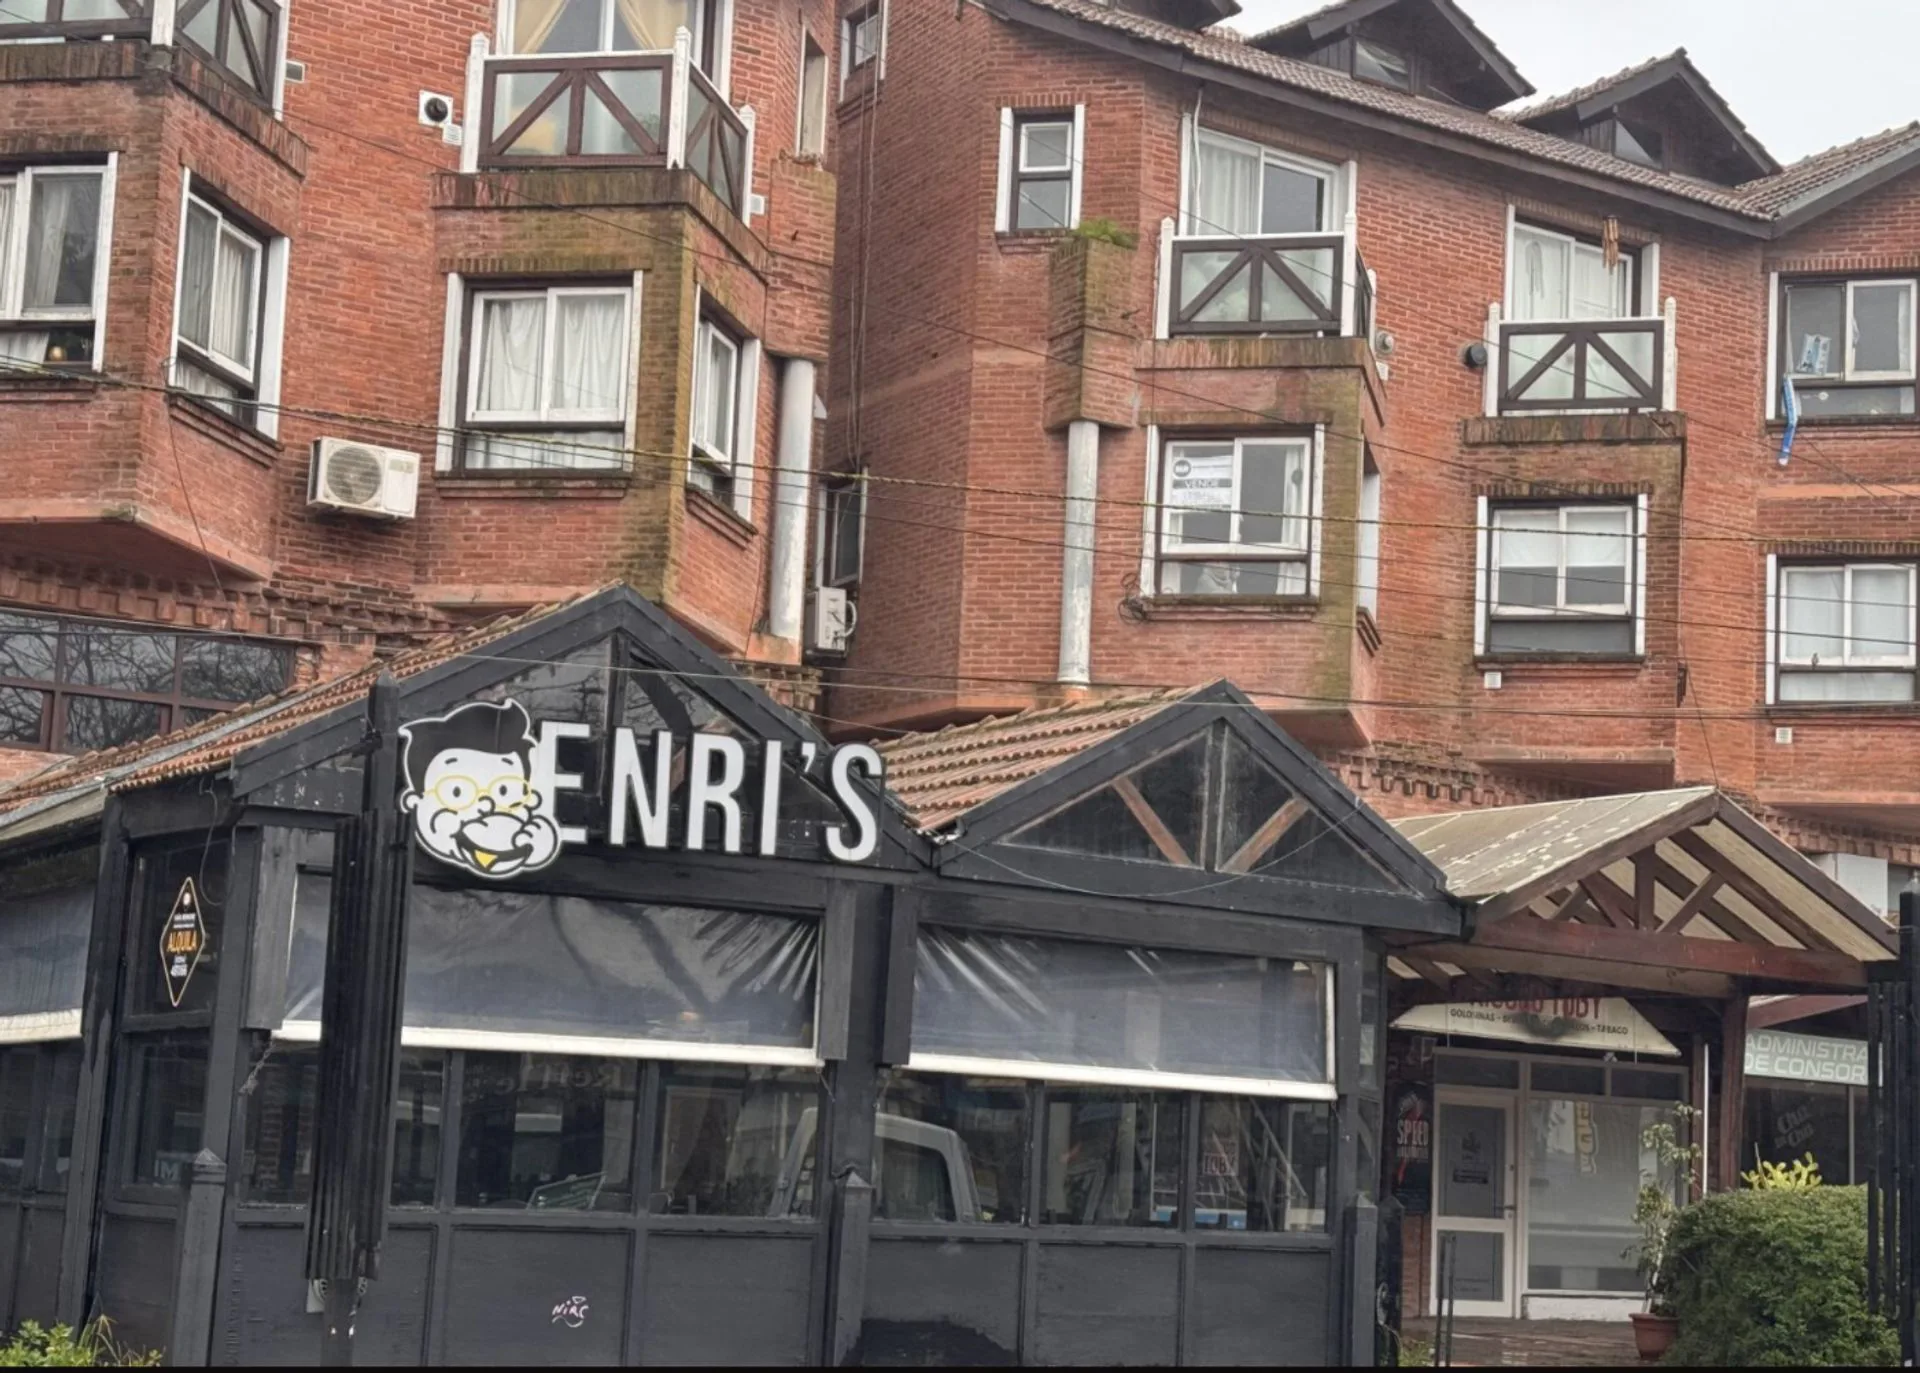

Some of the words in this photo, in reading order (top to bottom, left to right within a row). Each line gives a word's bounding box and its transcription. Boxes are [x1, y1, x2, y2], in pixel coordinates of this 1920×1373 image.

[537, 719, 883, 862] ENRI'S
[167, 930, 198, 954] ALQUILA
[1450, 1007, 1496, 1022] GOLOINAS
[1396, 1119, 1429, 1146] SPEED
